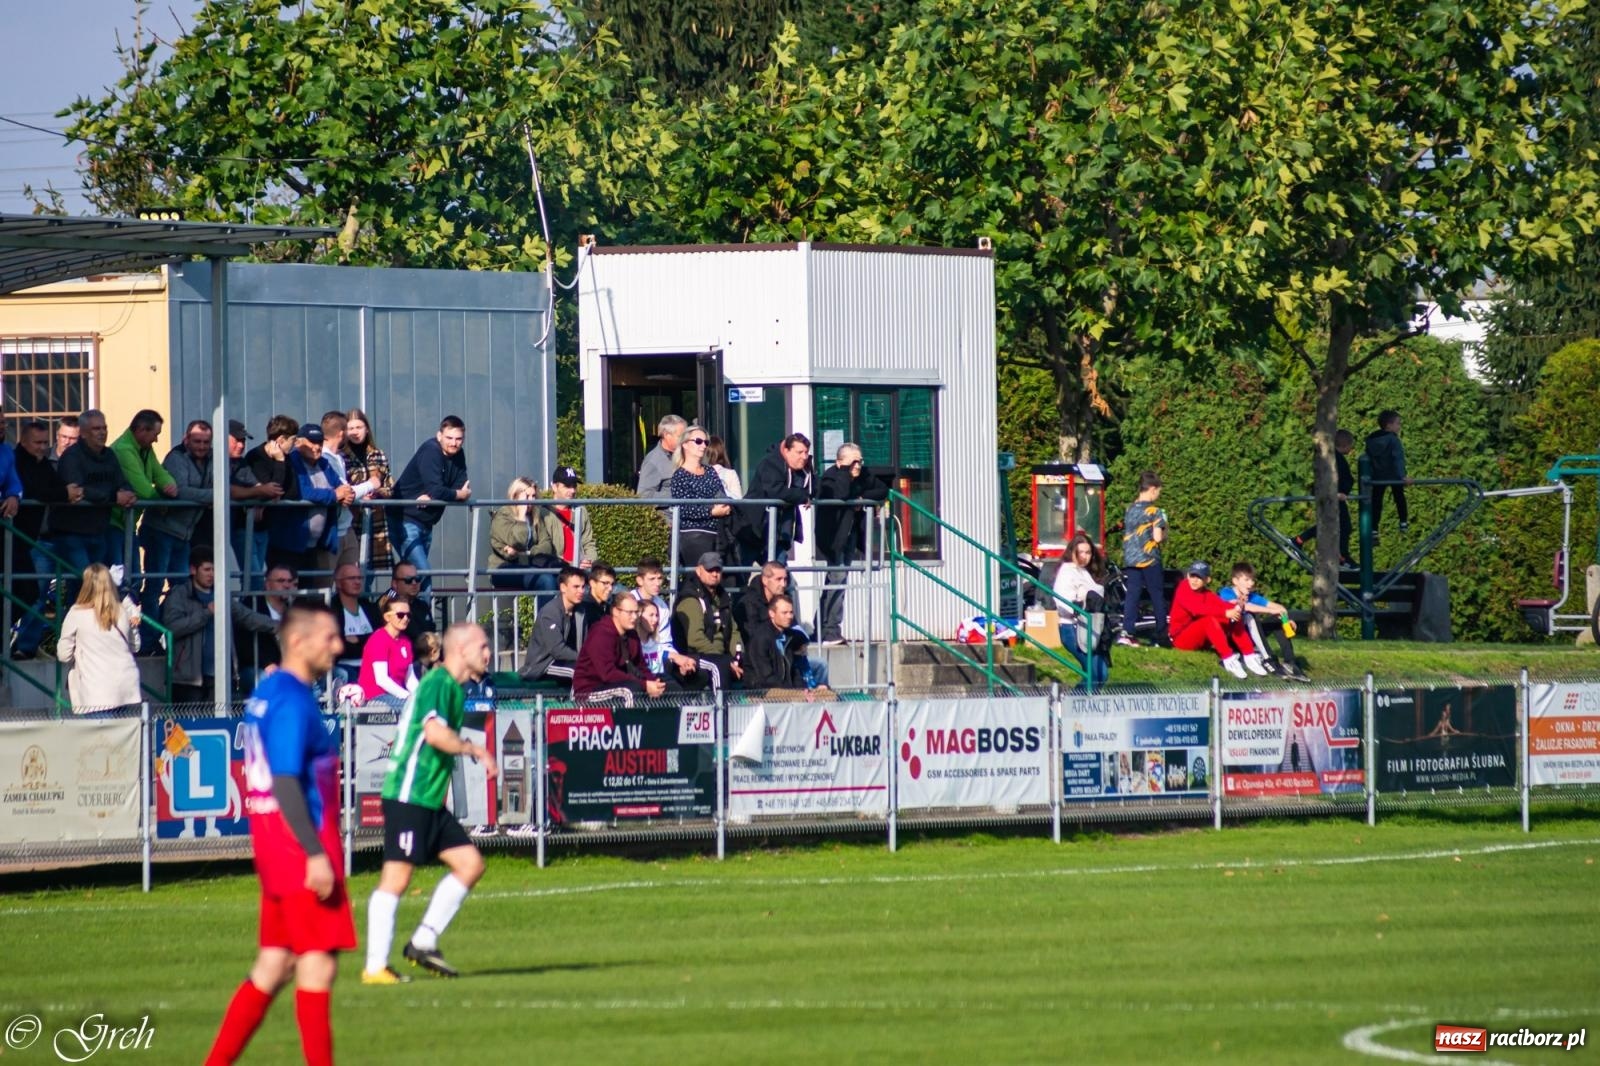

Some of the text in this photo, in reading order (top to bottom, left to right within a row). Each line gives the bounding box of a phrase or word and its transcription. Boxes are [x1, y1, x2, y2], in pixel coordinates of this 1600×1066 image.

[1071, 696, 1200, 716] ATRAKCJE NA TWOJE PRZYJĘCIE
[1293, 701, 1338, 728] SAXO
[550, 713, 605, 725] AUSTRIACKA UMOWA
[1228, 707, 1284, 726] PROJEKTY
[1228, 728, 1282, 741] DEWELOPERSKIE
[1555, 721, 1575, 733] OKNA
[568, 724, 643, 751] PRACA W
[1563, 737, 1598, 750] FASADOWE
[1250, 747, 1281, 757] FINANSOWE
[604, 749, 667, 775] AUSTRII
[1387, 753, 1506, 773] FILM I FOTOGRAFIA ŚLUBNA
[189, 750, 214, 798] L
[927, 769, 942, 779] GSM
[944, 768, 988, 779] ACCESSORIES
[996, 767, 1017, 777] SPARE
[1019, 766, 1041, 776] PARTS
[398, 831, 414, 856] 4
